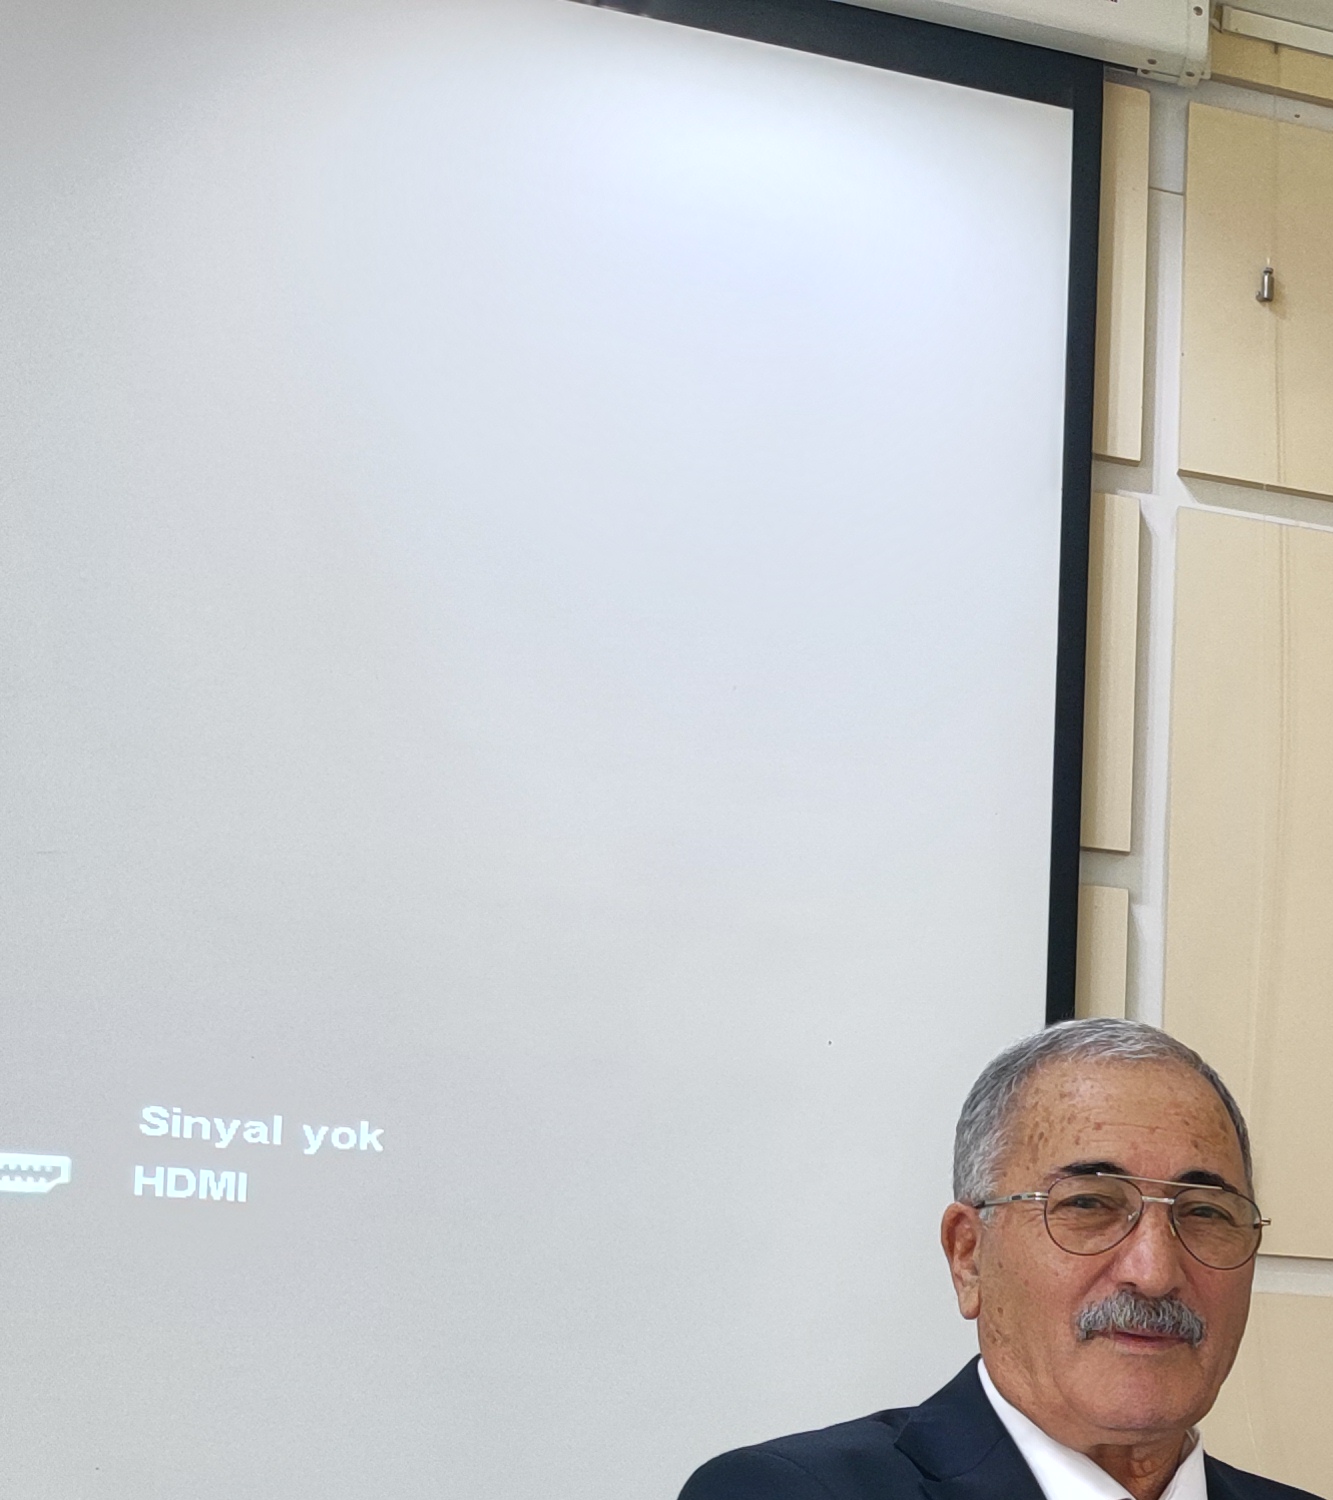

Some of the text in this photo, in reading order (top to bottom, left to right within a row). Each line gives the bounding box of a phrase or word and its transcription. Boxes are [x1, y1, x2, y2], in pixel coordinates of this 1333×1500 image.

[138, 1105, 385, 1155] Sinyal yok
[133, 1165, 248, 1203] HDMI
